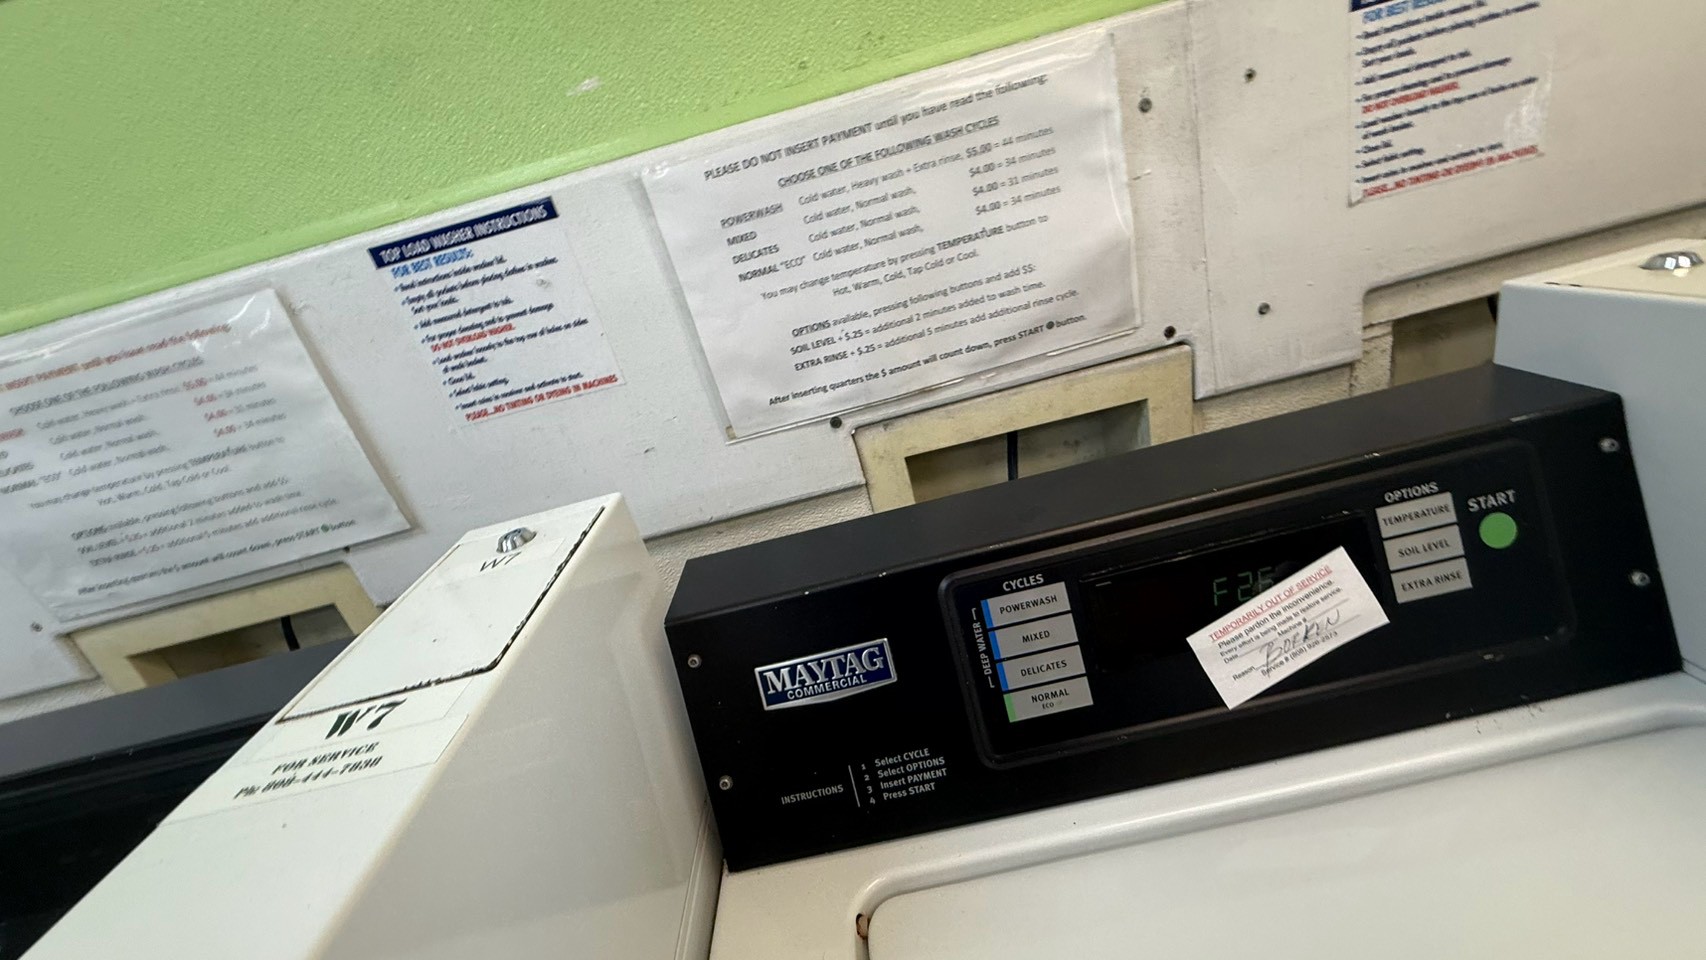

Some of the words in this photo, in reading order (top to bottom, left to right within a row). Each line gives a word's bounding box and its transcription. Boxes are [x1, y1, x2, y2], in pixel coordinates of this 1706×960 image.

[704, 161, 741, 180] PLEASE
[741, 156, 759, 169] DO
[759, 148, 782, 163] NOT
[783, 137, 819, 156] INSERT
[821, 122, 872, 145] PAYMENT
[874, 114, 898, 130] until
[899, 111, 920, 125] you
[921, 102, 948, 117] have
[948, 93, 974, 109] read
[974, 89, 994, 101] the
[777, 168, 817, 188] CHOOSE
[817, 161, 840, 177] ONE
[839, 157, 855, 171] OF
[853, 151, 875, 166] THE
[874, 135, 933, 161] FOLLOWING
[932, 125, 964, 144] WASH
[964, 115, 999, 135] CYCLES
[379, 246, 401, 263] TOP
[401, 238, 430, 257] LOAD
[429, 226, 474, 249] WASHER
[473, 204, 547, 236] INSTRUCTIONS
[726, 231, 757, 246] MIXED
[732, 244, 779, 264] DELICATES
[760, 290, 778, 299] You
[779, 284, 798, 295] may
[799, 275, 830, 289] change
[830, 260, 886, 281] temperature
[886, 257, 898, 265] by
[899, 246, 936, 263] pressing
[936, 225, 1004, 250] TEMPERATURE
[1005, 218, 1036, 232] button
[1037, 215, 1048, 223] to
[738, 264, 779, 282] NORMAL
[832, 286, 852, 296] Hot,
[851, 278, 883, 290] Warm,
[883, 270, 906, 282] Cold,
[906, 266, 924, 275] Tap
[924, 258, 944, 270] Cold
[944, 256, 955, 265] or
[791, 319, 831, 337] OPTIONS
[872, 299, 909, 317] pressing
[909, 288, 948, 304] following
[949, 278, 983, 293] buttons
[984, 272, 1002, 284] and
[1003, 267, 1020, 279] add
[789, 343, 810, 355] SOIL
[810, 336, 836, 349] LEVEL
[769, 394, 789, 406] After
[790, 385, 828, 399] inserting
[828, 376, 864, 391] quarters
[864, 372, 879, 381] the
[888, 359, 921, 375] amount
[922, 353, 938, 364] will
[938, 347, 963, 360] count
[993, 334, 1017, 347] press
[1017, 324, 1044, 339] START
[794, 357, 822, 371] EXTRA
[823, 350, 848, 363] RINSE
[1384, 481, 1438, 502] OPTIONS
[1467, 489, 1515, 511] START
[1382, 503, 1450, 526] TEMPERATURE
[1398, 545, 1420, 557] SOIL
[1422, 538, 1450, 552] LEVEL
[479, 551, 523, 572] W7
[1002, 573, 1043, 591] CYCLES
[1401, 577, 1433, 591] EXTRA
[1434, 571, 1461, 584] RINSE
[999, 594, 1057, 614] POWERWASH
[1209, 606, 1265, 642] TEMPORARILY
[1264, 593, 1284, 610] OUT
[1282, 585, 1297, 600] OF
[1295, 565, 1332, 592] SERVICE
[1217, 632, 1243, 649] Please
[1243, 617, 1269, 636] pardon
[1268, 609, 1282, 619] the
[1281, 579, 1333, 612] inconvenience.
[1219, 646, 1237, 657] Every
[1237, 637, 1254, 648] effort
[1259, 625, 1277, 637] being
[1276, 615, 1293, 627] made
[1299, 599, 1320, 613] restore
[1319, 587, 1341, 602] service.
[972, 621, 986, 651] WATER
[1022, 630, 1050, 643] MIXED
[1223, 653, 1238, 664] Date
[1276, 621, 1302, 637] Machine
[762, 647, 883, 693] MAYTAG
[979, 652, 992, 675] DEEP
[1020, 659, 1067, 676] DELICATES
[1232, 665, 1256, 680] Reason
[787, 675, 869, 699] COMMERCIAL
[1031, 688, 1069, 703] NORMAL
[1041, 701, 1054, 709] ECO
[322, 698, 406, 738] W7
[271, 756, 306, 775] FOR
[305, 740, 380, 767] SERVICE
[874, 754, 902, 766] Select
[903, 747, 930, 760] CYCLE
[877, 765, 904, 778] Select
[905, 756, 945, 771] OPTIONS
[866, 785, 872, 793] 3
[880, 777, 906, 789] Insert
[907, 767, 946, 783] PAYMENT
[781, 784, 843, 804] INSTRUCTIONS
[869, 796, 875, 804] 4
[882, 789, 907, 800] Press
[908, 782, 935, 794] START
